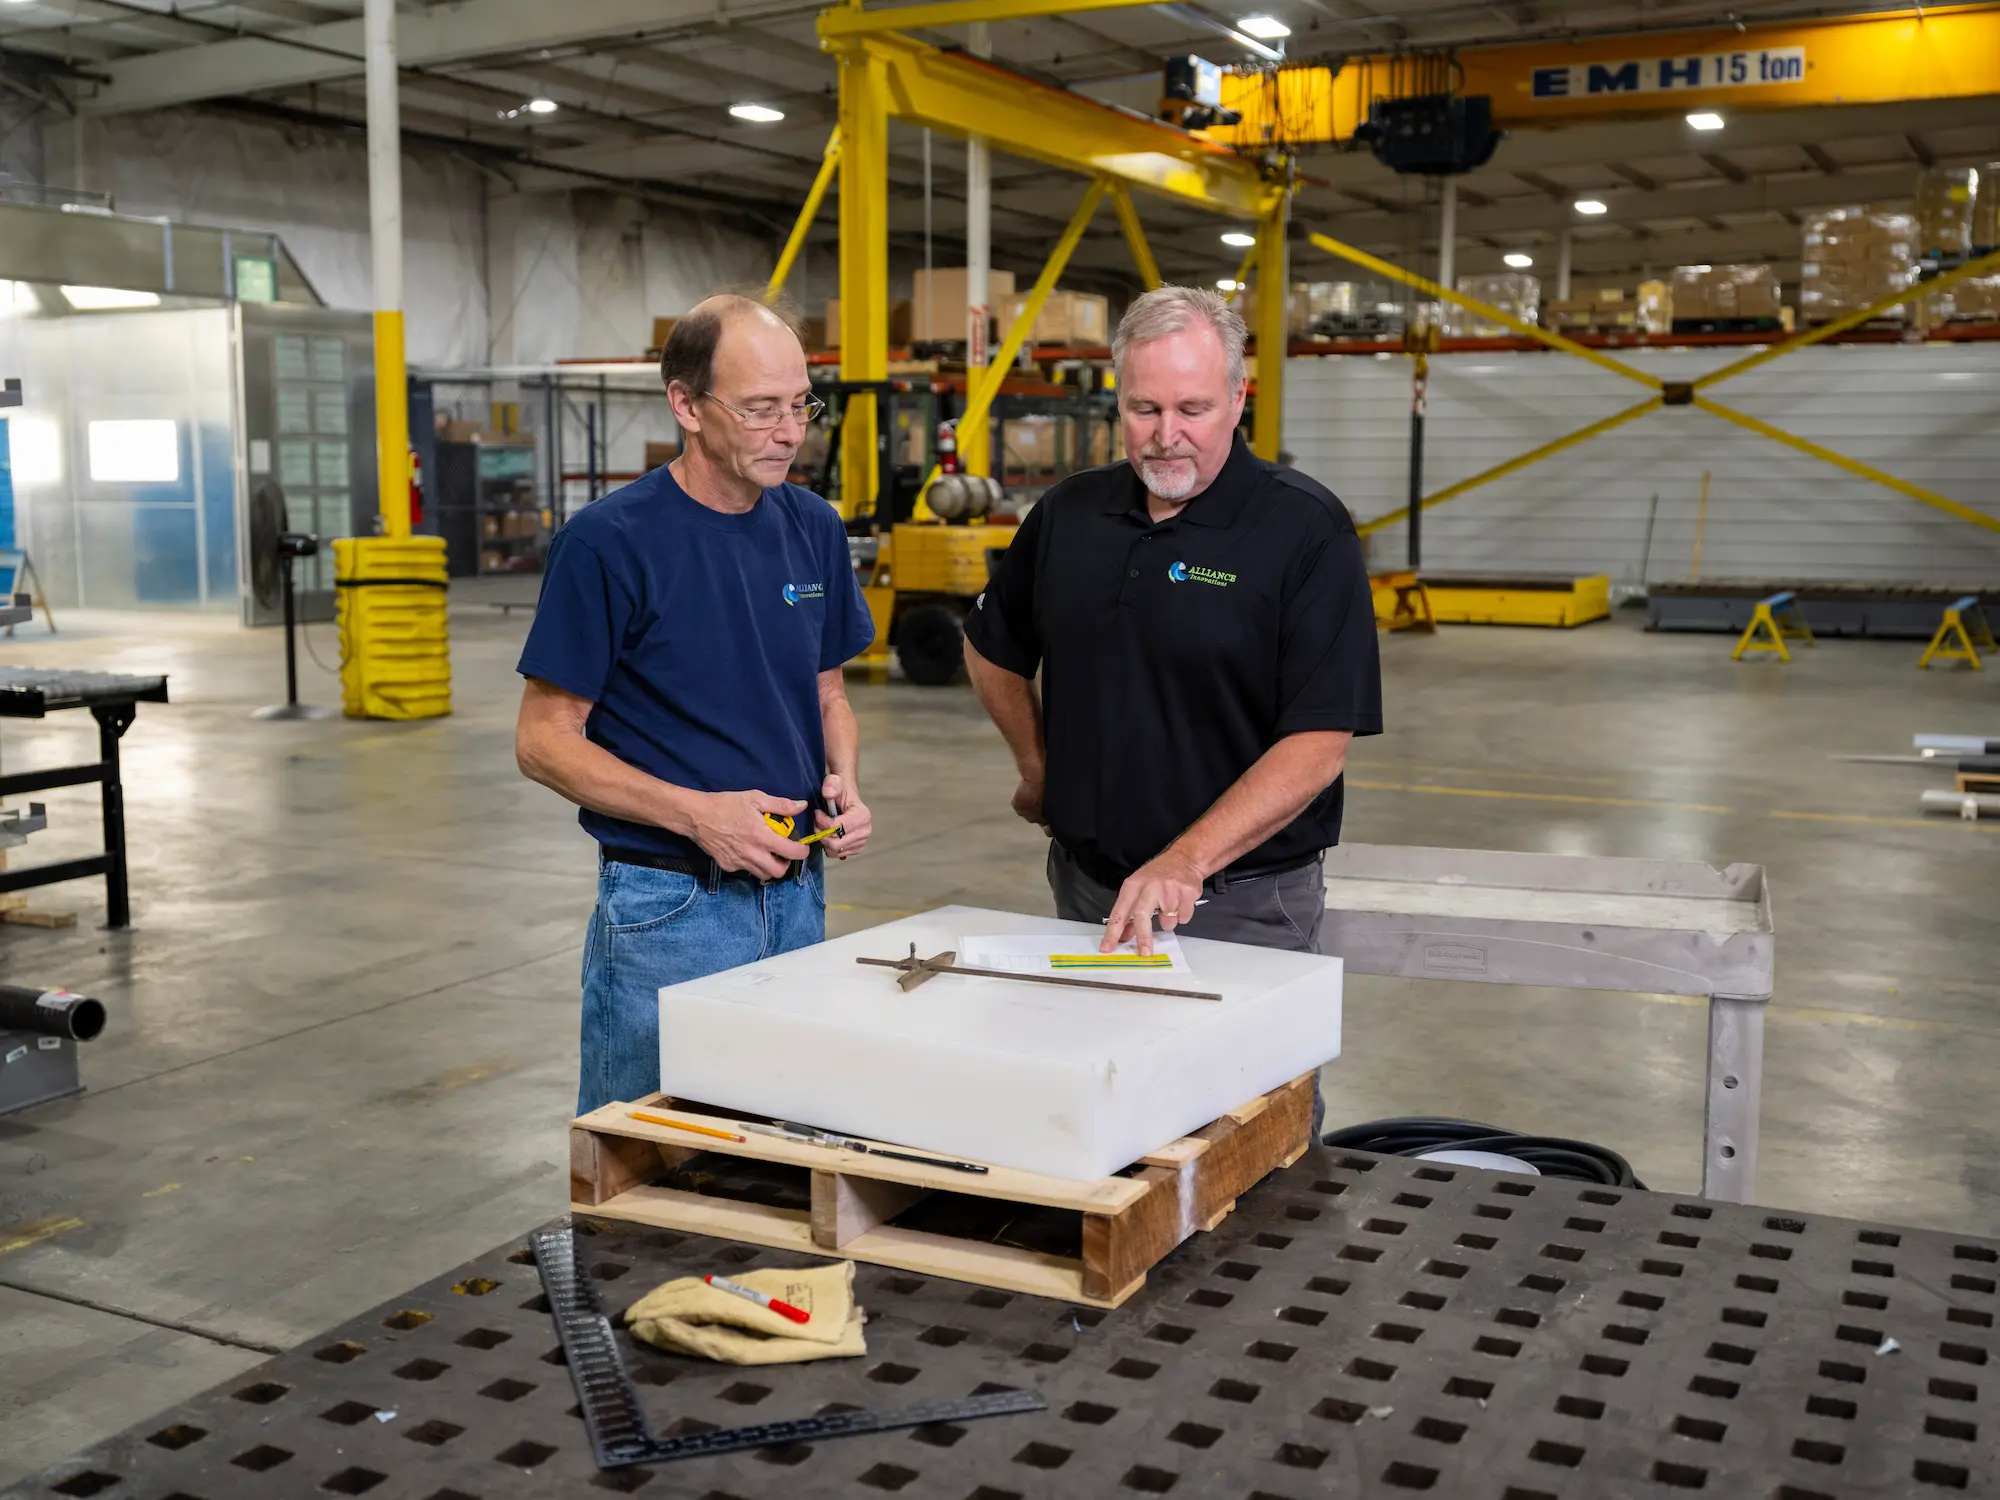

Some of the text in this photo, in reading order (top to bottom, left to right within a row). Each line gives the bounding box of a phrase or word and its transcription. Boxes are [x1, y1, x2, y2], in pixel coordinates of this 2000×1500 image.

[1715, 53, 1748, 83] 15
[1760, 51, 1801, 81] ton
[1188, 566, 1237, 582] ALLIANCE
[795, 582, 824, 592] ALLIANC
